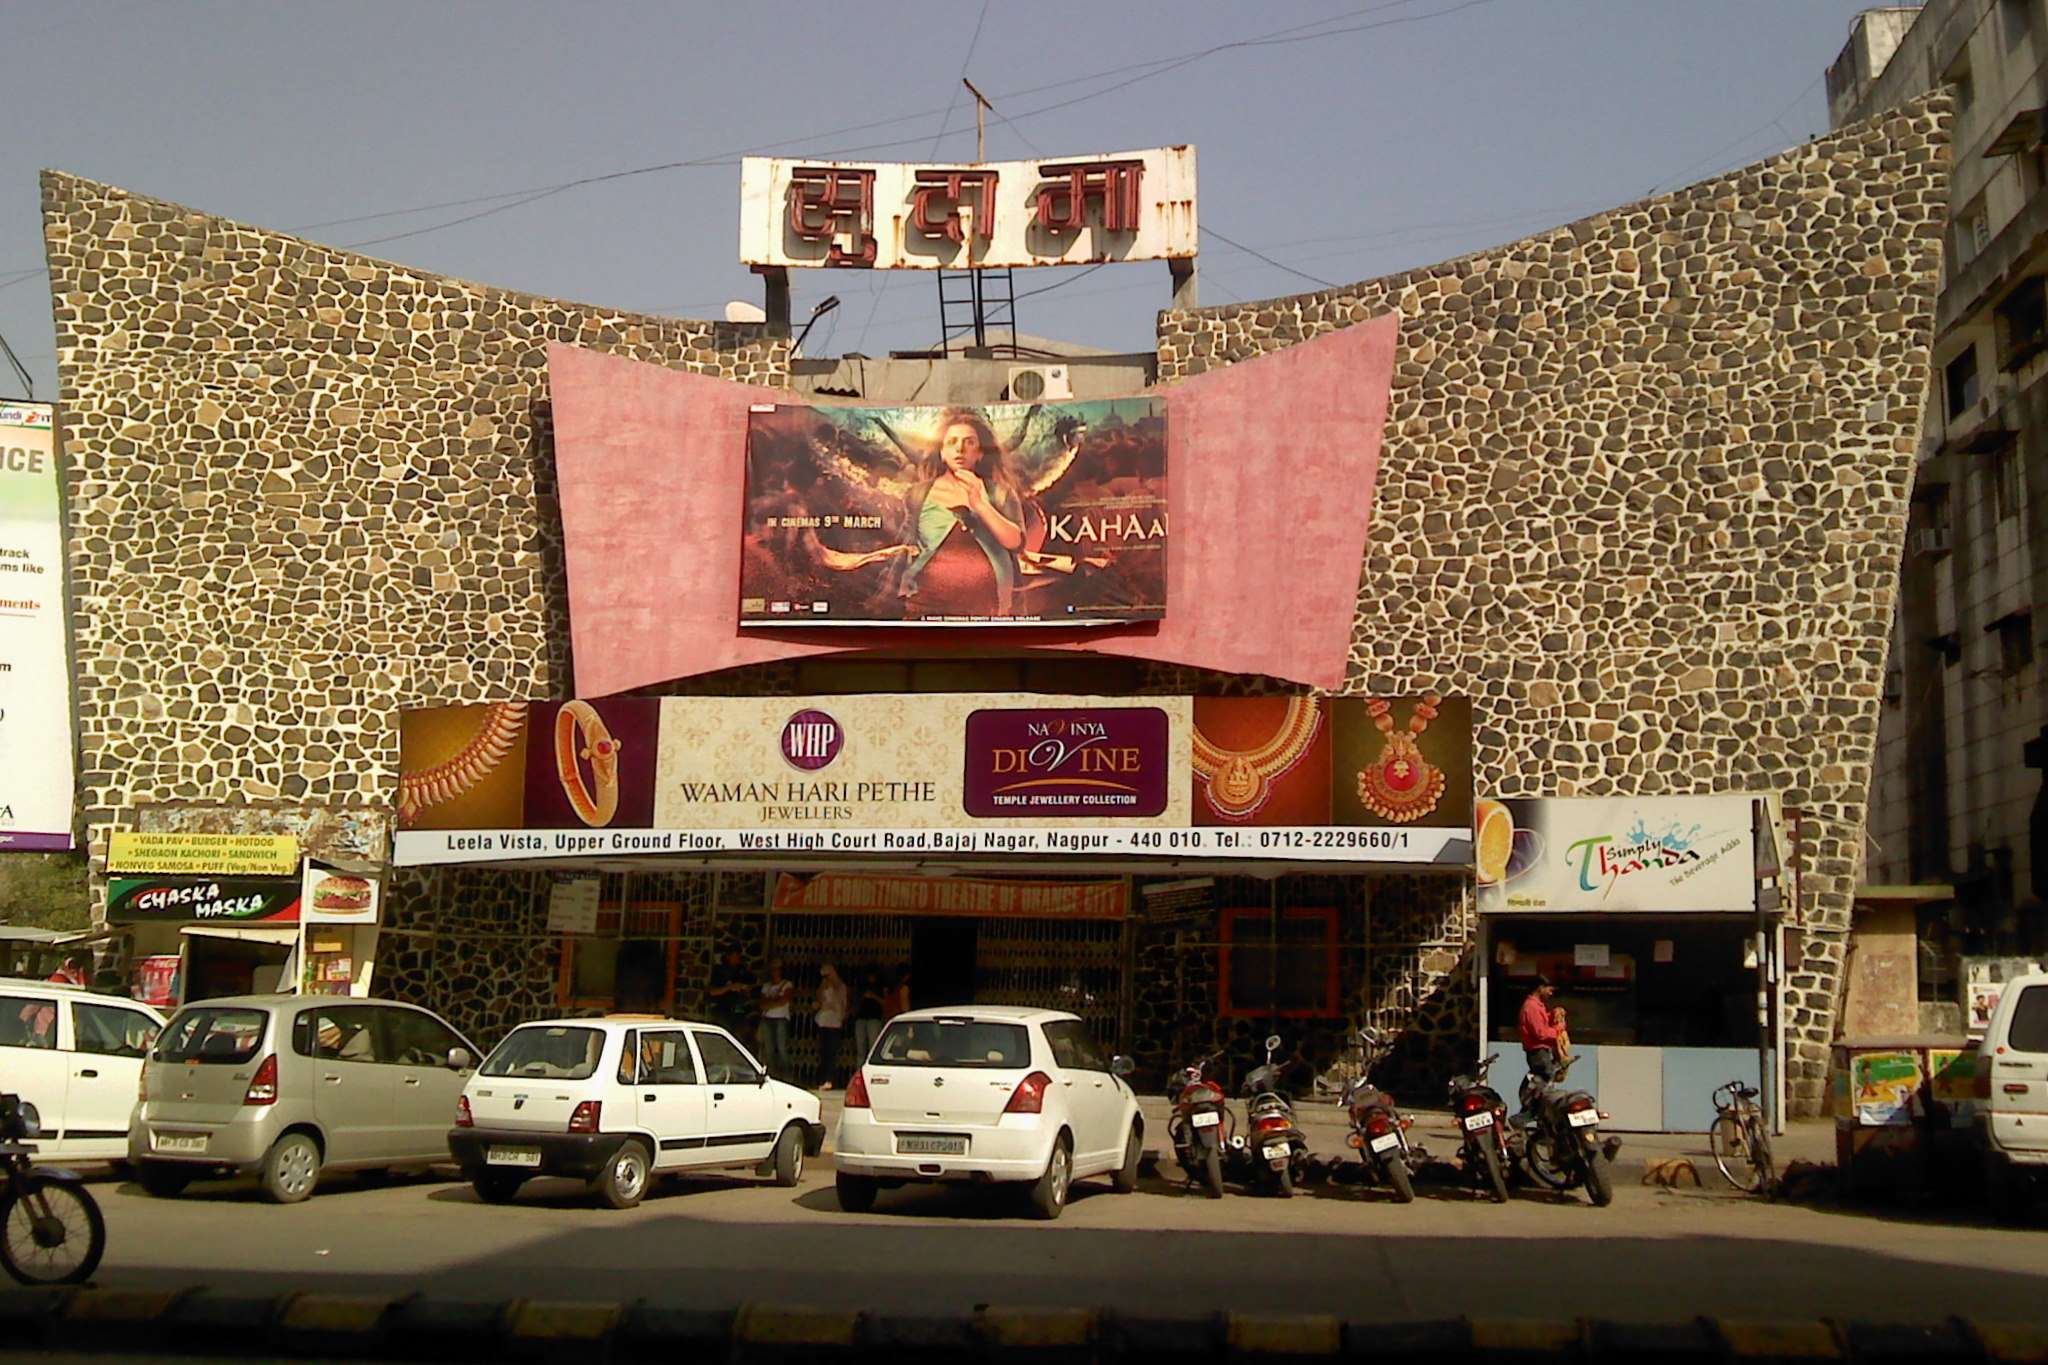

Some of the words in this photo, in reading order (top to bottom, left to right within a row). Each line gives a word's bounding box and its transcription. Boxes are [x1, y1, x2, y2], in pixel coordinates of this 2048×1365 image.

[781, 517, 820, 528] CINEMAS
[844, 515, 882, 528] MARCH
[22, 563, 45, 574] like
[790, 723, 834, 757] WHP
[992, 736, 1142, 773] DIVINE
[681, 782, 779, 802] WAMAN
[788, 782, 848, 802] HARI
[857, 781, 936, 802] PETHE
[993, 795, 1027, 806] TEMPLE
[1030, 795, 1080, 805] JEWELLERY
[1083, 795, 1137, 805] COLLECTION
[761, 805, 852, 822] JEWELLERS
[140, 837, 164, 845] VADA
[166, 837, 184, 846] PAV
[192, 838, 228, 846] BURGER
[235, 838, 275, 847] HOTDOG
[448, 834, 492, 850] Leela
[500, 833, 548, 851] Vista,
[555, 833, 605, 852] Upper
[612, 833, 672, 849] Ground
[679, 832, 726, 849] Floor,
[739, 832, 780, 848] West
[787, 832, 824, 850] High
[832, 832, 876, 848] Court
[985, 832, 1039, 850] Nagar,
[1047, 832, 1109, 850] Nagpur
[1130, 832, 1161, 848] 440
[1260, 831, 1408, 850] 0712-2229660/1
[1607, 839, 1662, 861] Simply
[134, 848, 176, 858] SHEGAON
[180, 849, 221, 858] KACHORI
[228, 850, 277, 860] SANDWICH
[116, 861, 154, 870] NONVEG
[157, 862, 194, 871] SAMOSA
[201, 862, 224, 871] PUFF
[138, 883, 220, 911] CHASKA
[195, 894, 263, 919] MASKA
[934, 882, 994, 910] THEATRE
